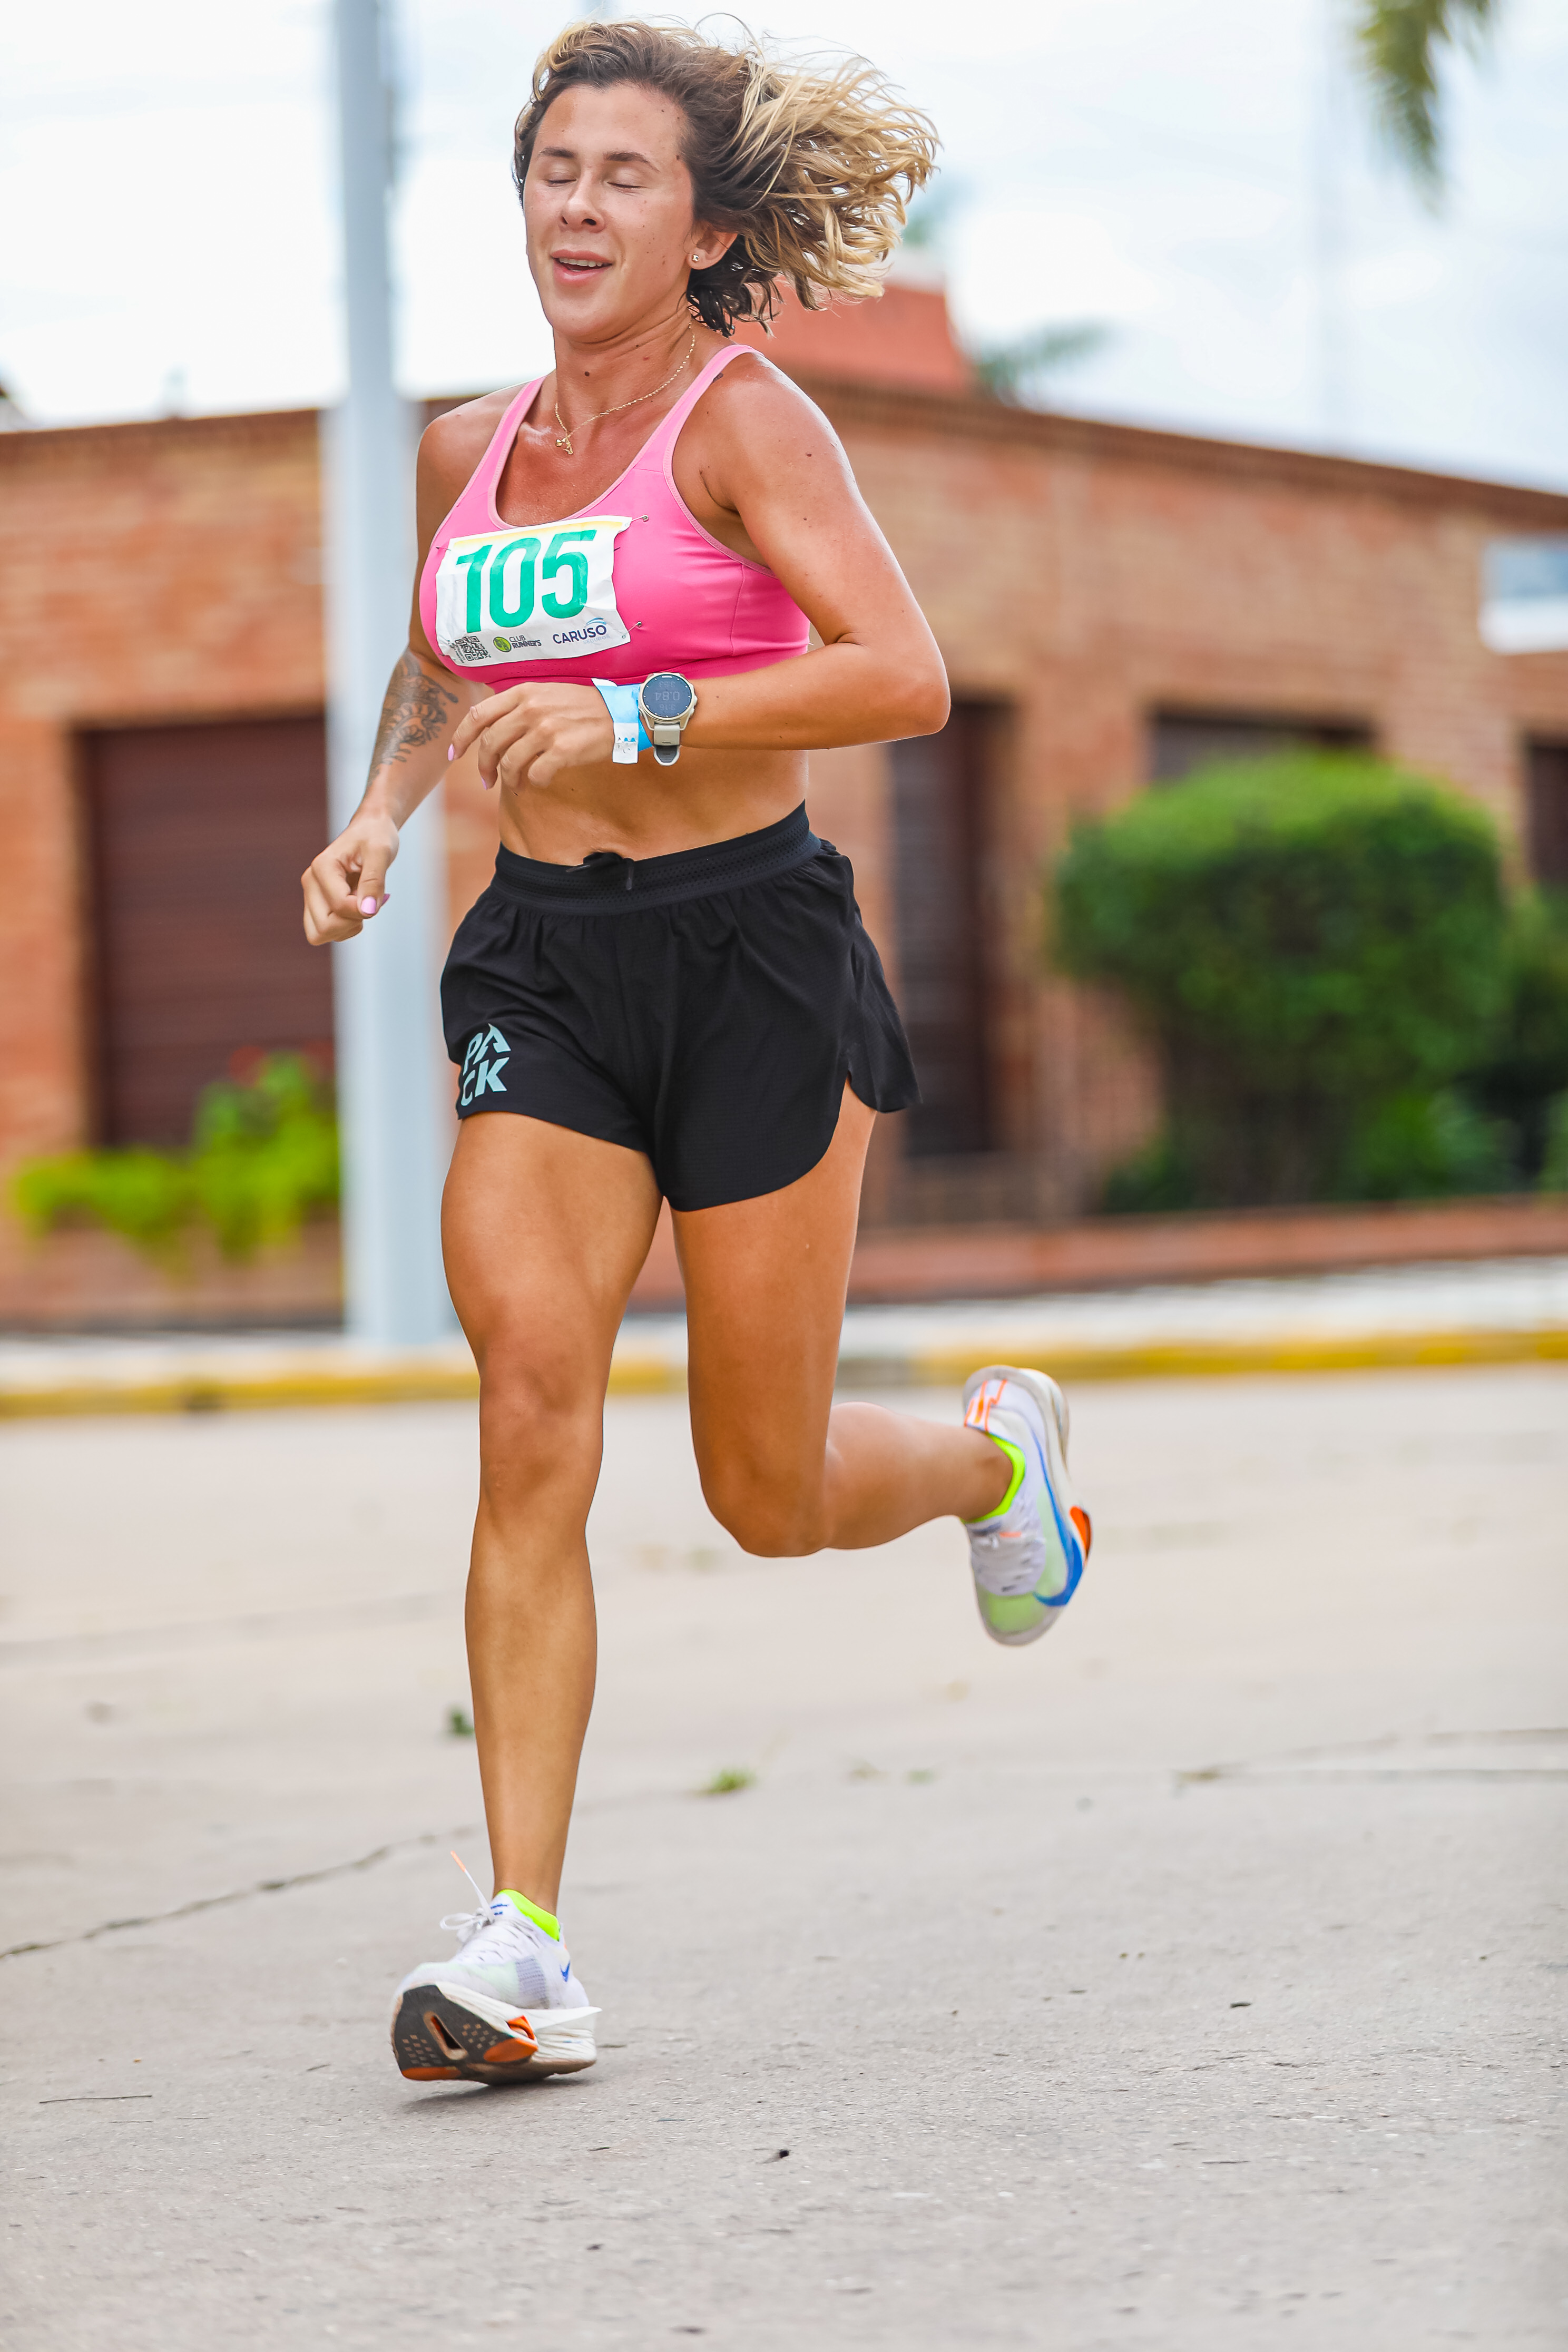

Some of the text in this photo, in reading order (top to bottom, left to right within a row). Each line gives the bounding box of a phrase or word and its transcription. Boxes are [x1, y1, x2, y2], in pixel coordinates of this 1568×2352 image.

[456, 530, 597, 633] 105
[552, 625, 606, 644] CARUSO
[583, 634, 610, 644] SEGUROS
[654, 691, 680, 701] 0.84
